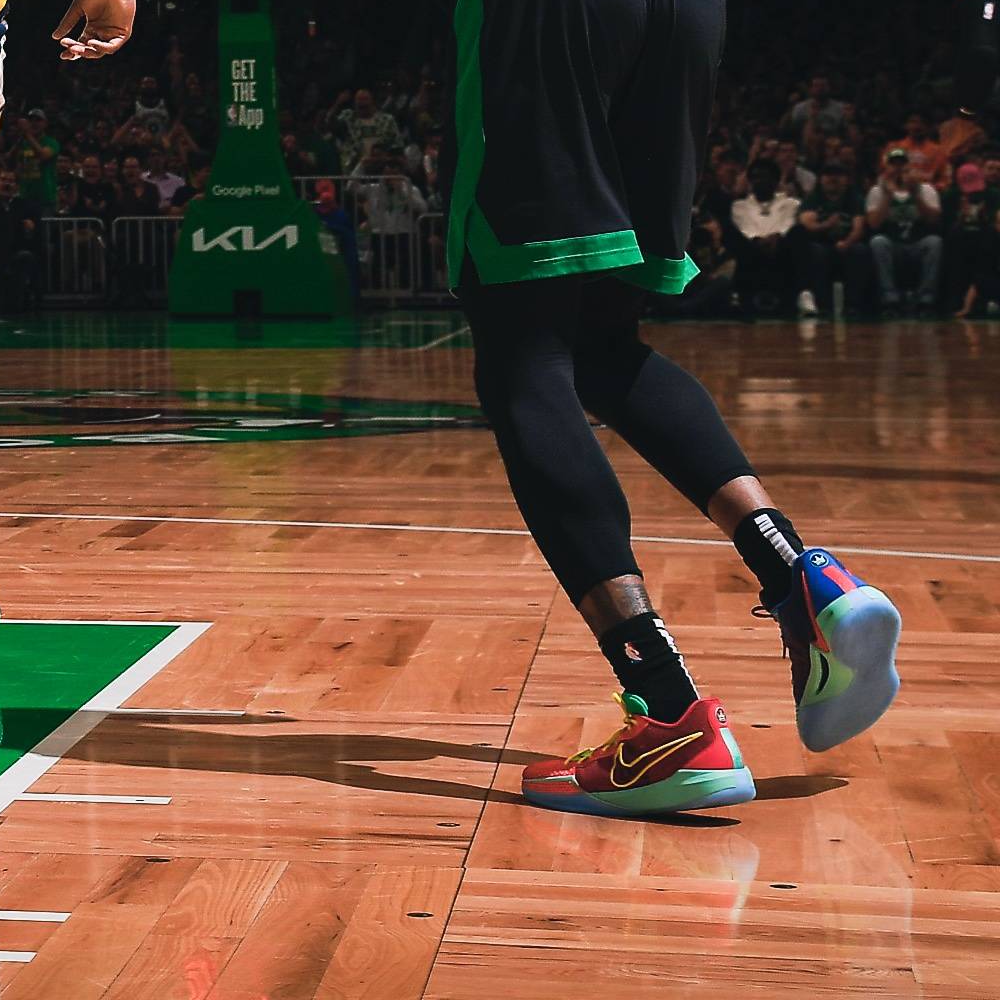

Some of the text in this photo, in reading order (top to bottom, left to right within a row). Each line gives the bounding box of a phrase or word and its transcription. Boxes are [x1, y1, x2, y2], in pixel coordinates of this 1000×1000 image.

[231, 58, 257, 80] GET
[231, 81, 258, 103] THE
[238, 104, 265, 130] App
[211, 184, 281, 199] Google Pixel
[191, 224, 299, 252] KIA
